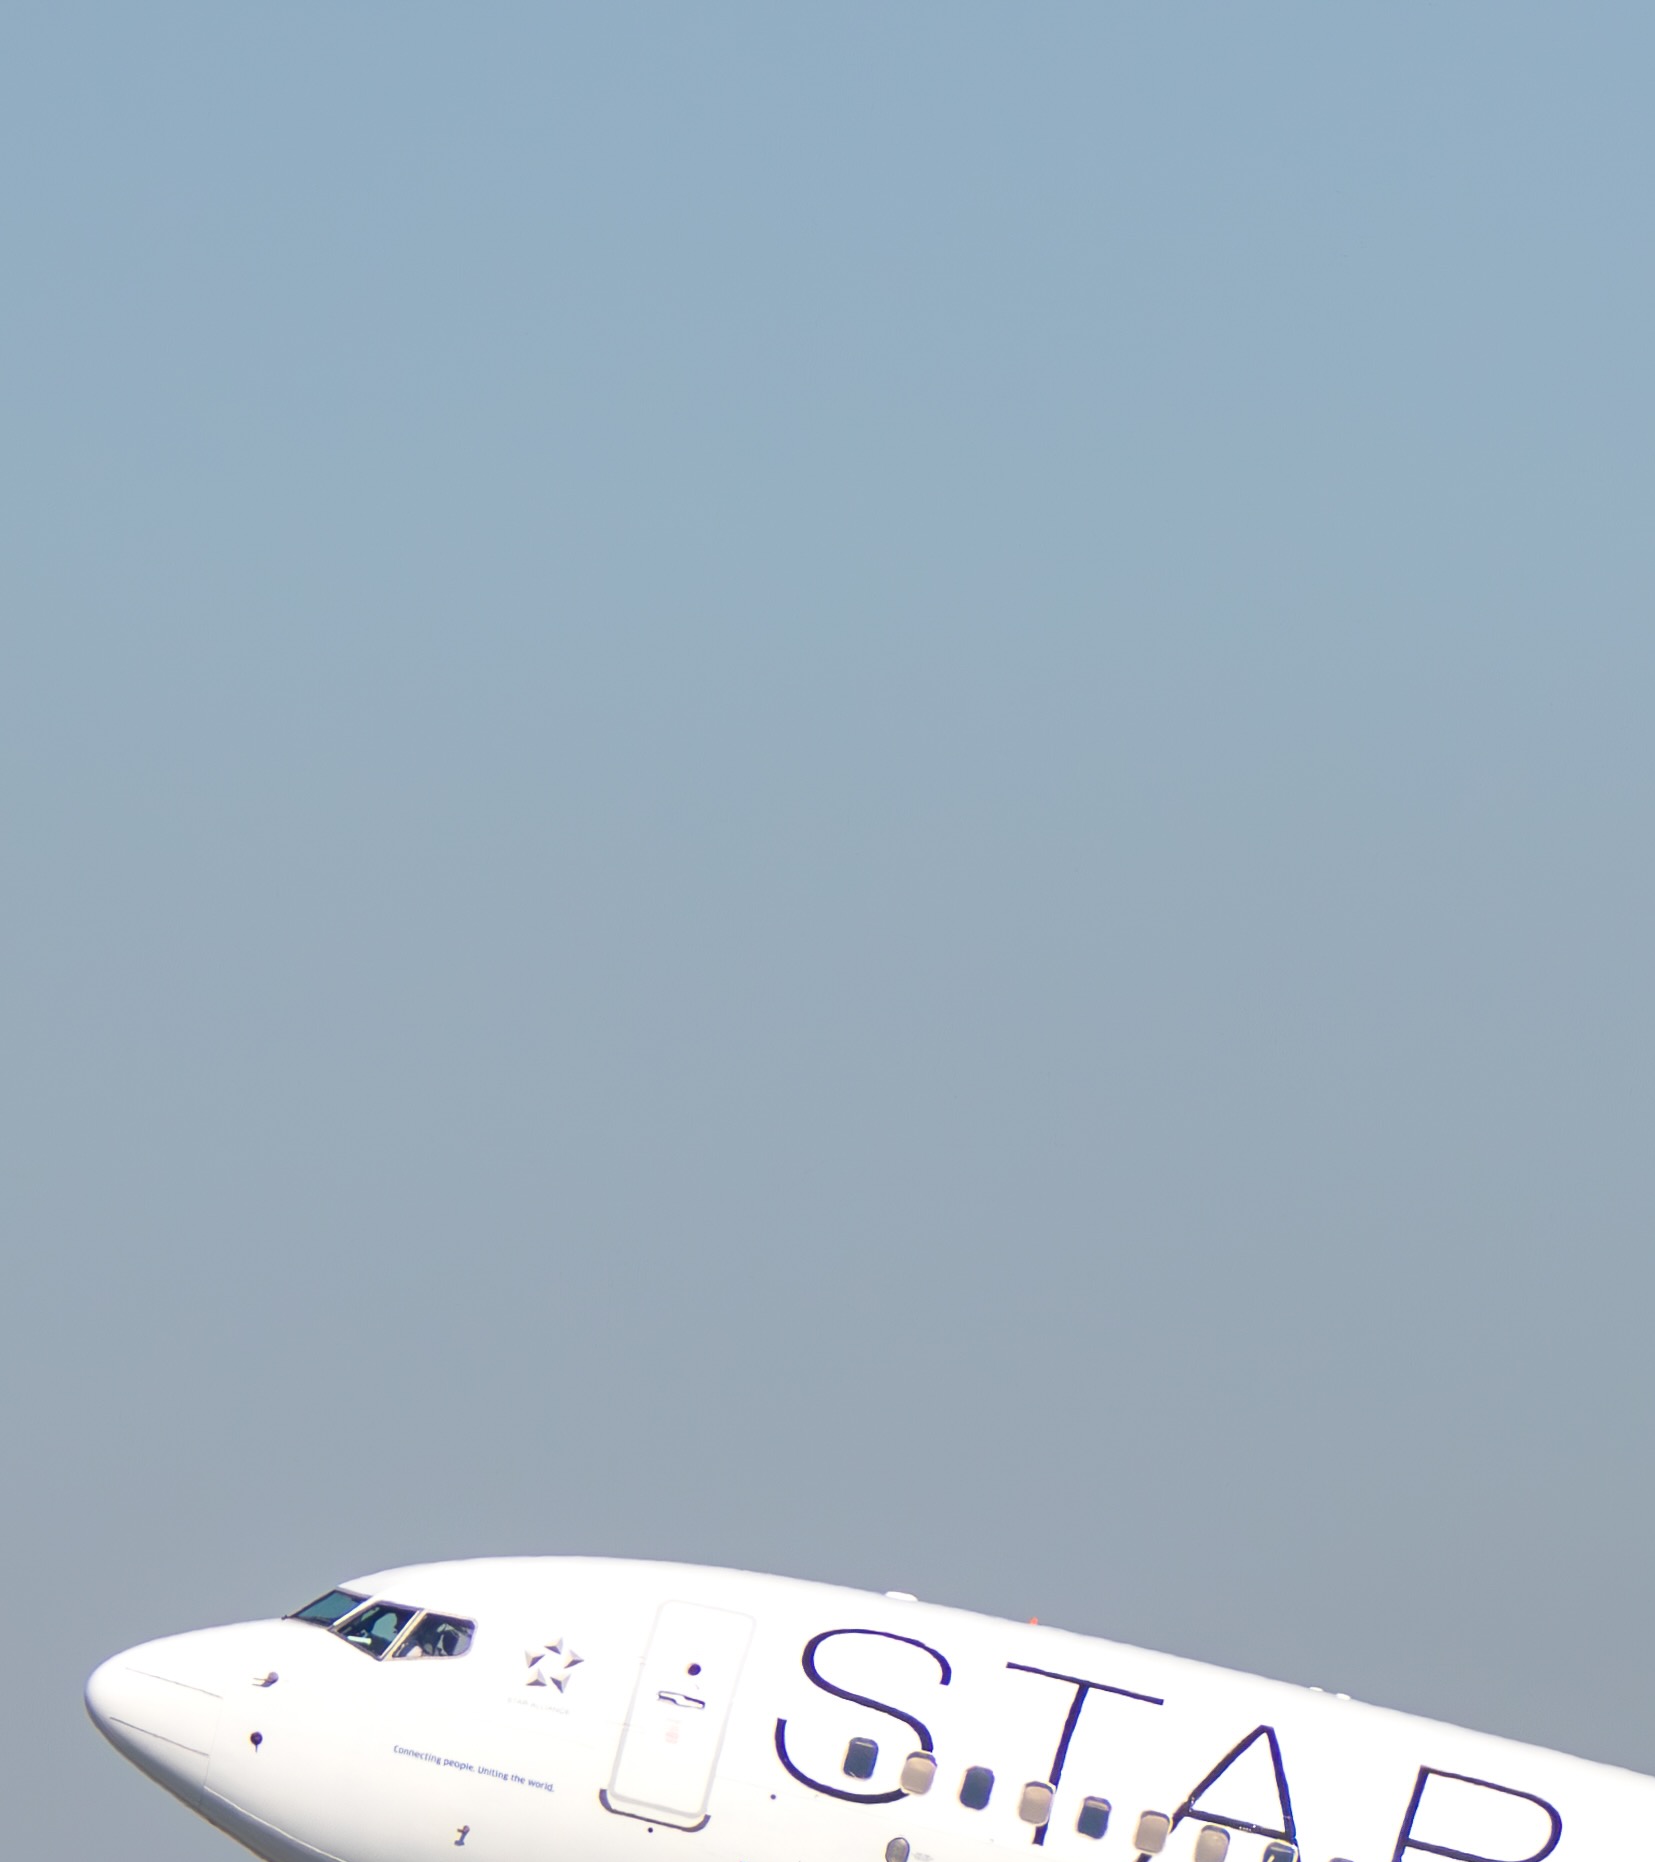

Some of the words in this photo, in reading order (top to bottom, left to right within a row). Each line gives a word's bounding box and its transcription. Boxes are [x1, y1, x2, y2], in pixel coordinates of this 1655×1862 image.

[393, 1745, 441, 1765] Connecting
[443, 1758, 475, 1771] people.
[477, 1766, 508, 1781] Uniting
[510, 1774, 525, 1784] the
[528, 1779, 555, 1792] world.
